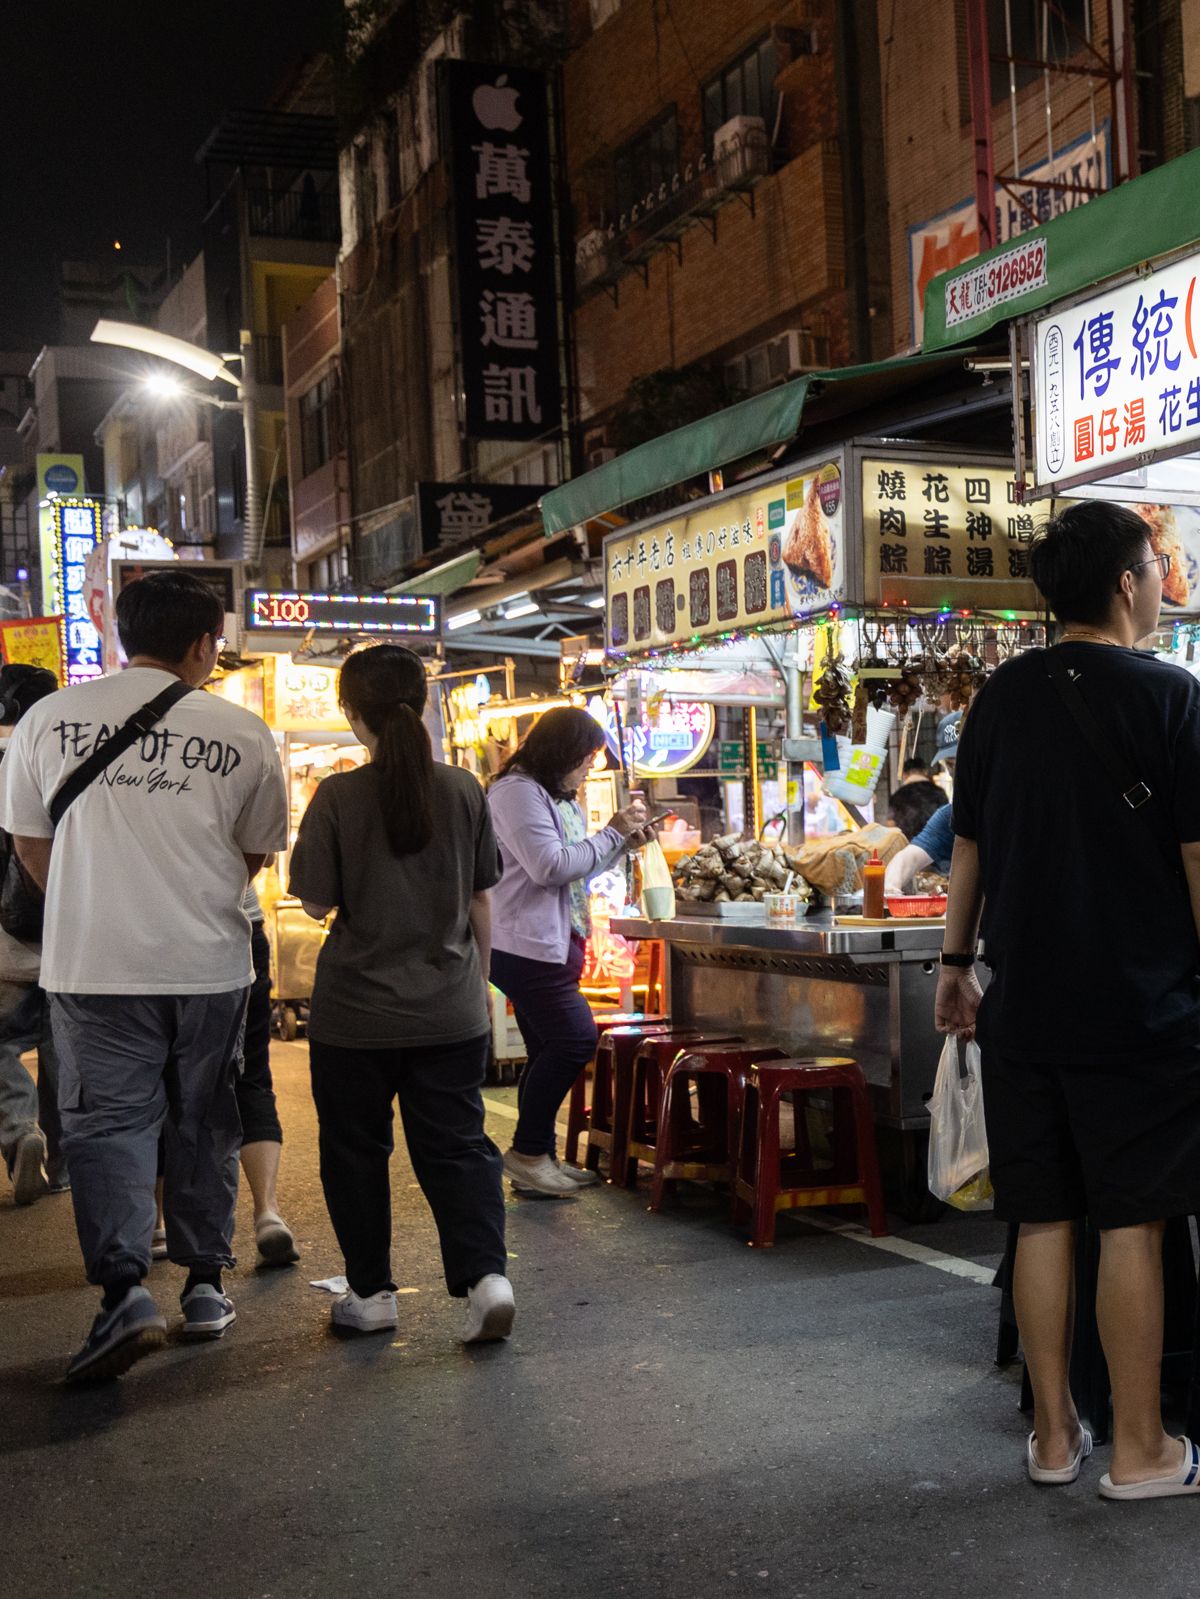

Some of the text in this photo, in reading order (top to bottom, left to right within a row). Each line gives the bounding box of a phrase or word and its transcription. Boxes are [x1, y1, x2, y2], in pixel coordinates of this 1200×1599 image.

[471, 142, 543, 425] 萬泰通訊
[973, 274, 988, 292] TEL
[987, 246, 1043, 298] 3126952
[1073, 398, 1146, 463] 圓仔湯
[877, 469, 908, 575] 燒肉粽
[922, 473, 952, 575] 花生粽
[965, 477, 994, 577] 四神湯
[612, 529, 675, 582] 六十年老店
[53, 719, 242, 778] FEA OF GOD
[99, 763, 193, 796] New York
